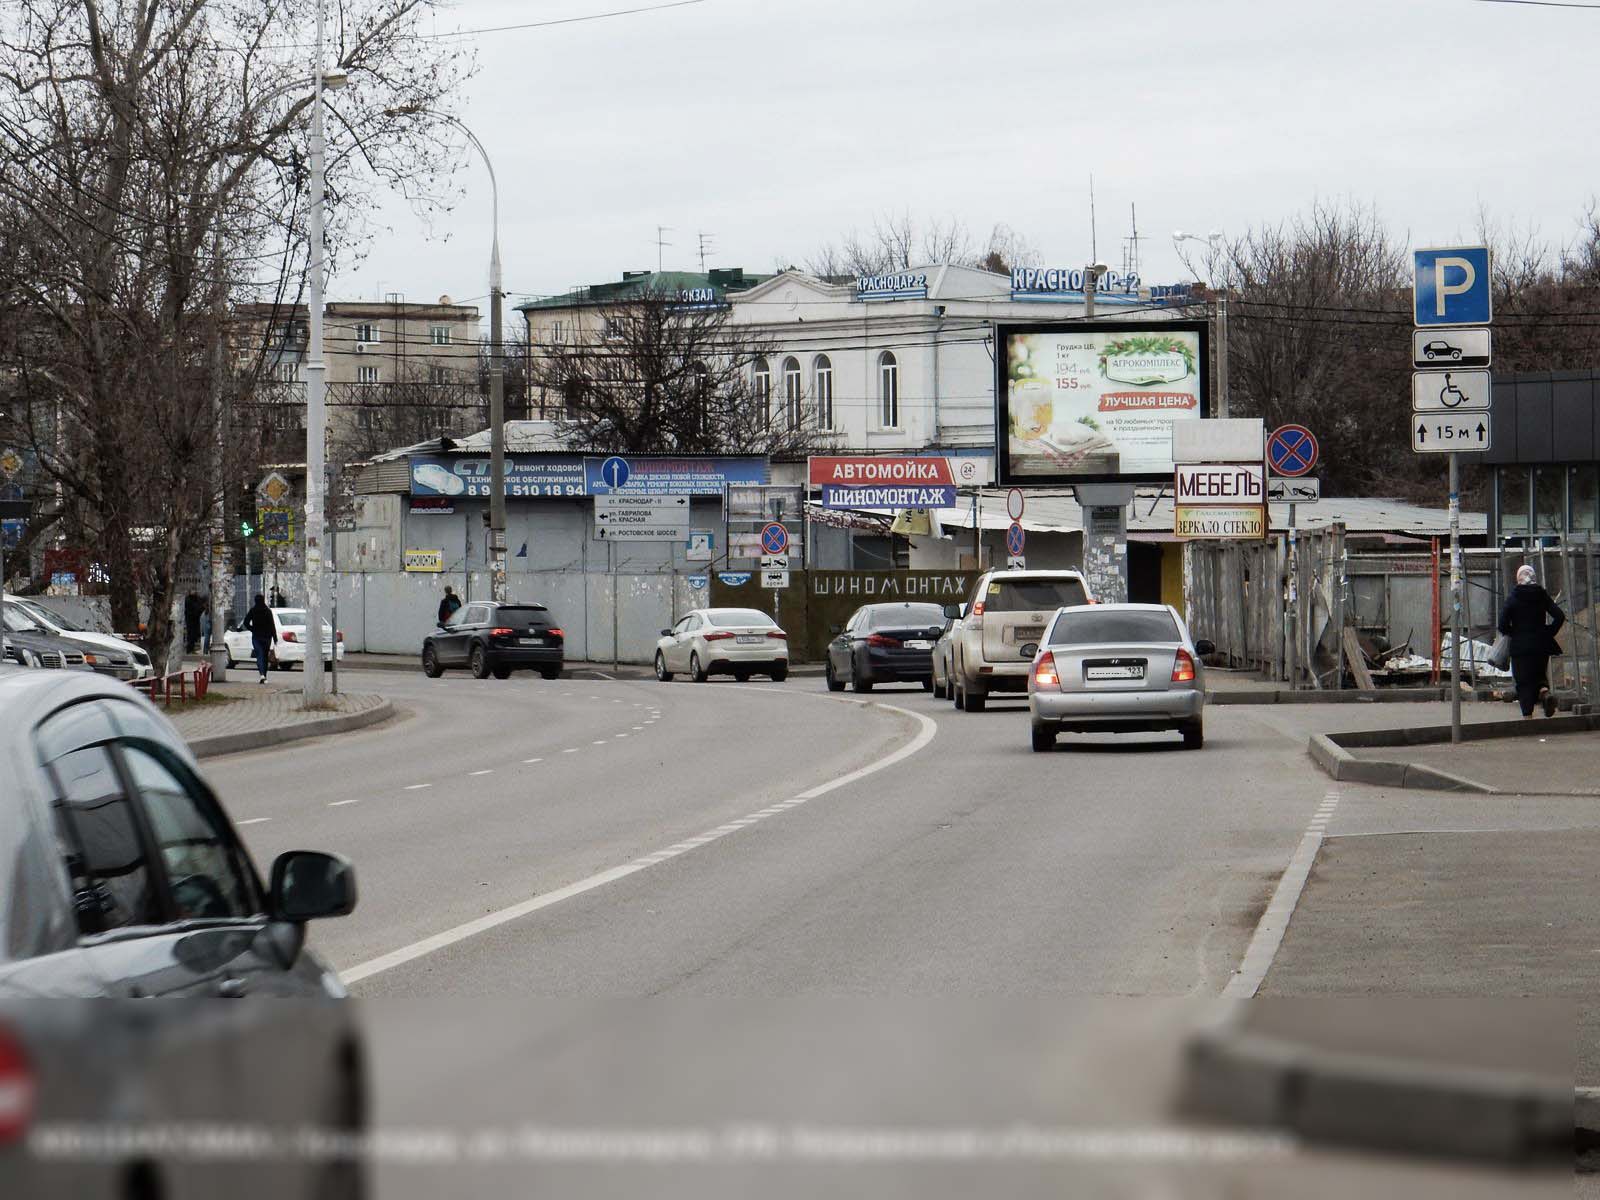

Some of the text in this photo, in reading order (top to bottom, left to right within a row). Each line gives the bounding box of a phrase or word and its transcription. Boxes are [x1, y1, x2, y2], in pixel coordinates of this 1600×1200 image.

[855, 274, 927, 292] КРАСНОДАР-2
[1434, 256, 1476, 316] P
[1056, 343, 1083, 351] Грудка
[1112, 358, 1182, 368] АГРОКОМПЛЕКС
[1056, 377, 1079, 389] 155
[1105, 396, 1156, 407] ЛУЧШАЯ
[1437, 425, 1469, 439] 15 м
[514, 464, 545, 472] РЕМОНТ
[546, 463, 583, 472] ХОДОВОЙ
[832, 461, 939, 479] АВТОМОЙКА
[468, 485, 477, 496] 8
[512, 485, 540, 496] 510
[544, 485, 559, 496] 18
[565, 485, 584, 496] 94
[1179, 472, 1261, 496] МЕБЕЛЬ
[829, 488, 946, 506] ШИНОМОНТАЖ
[1177, 520, 1261, 534] ЗЕРКАЛО СТЕКЛО
[814, 576, 966, 595] ШИНОМОНТАЖ
